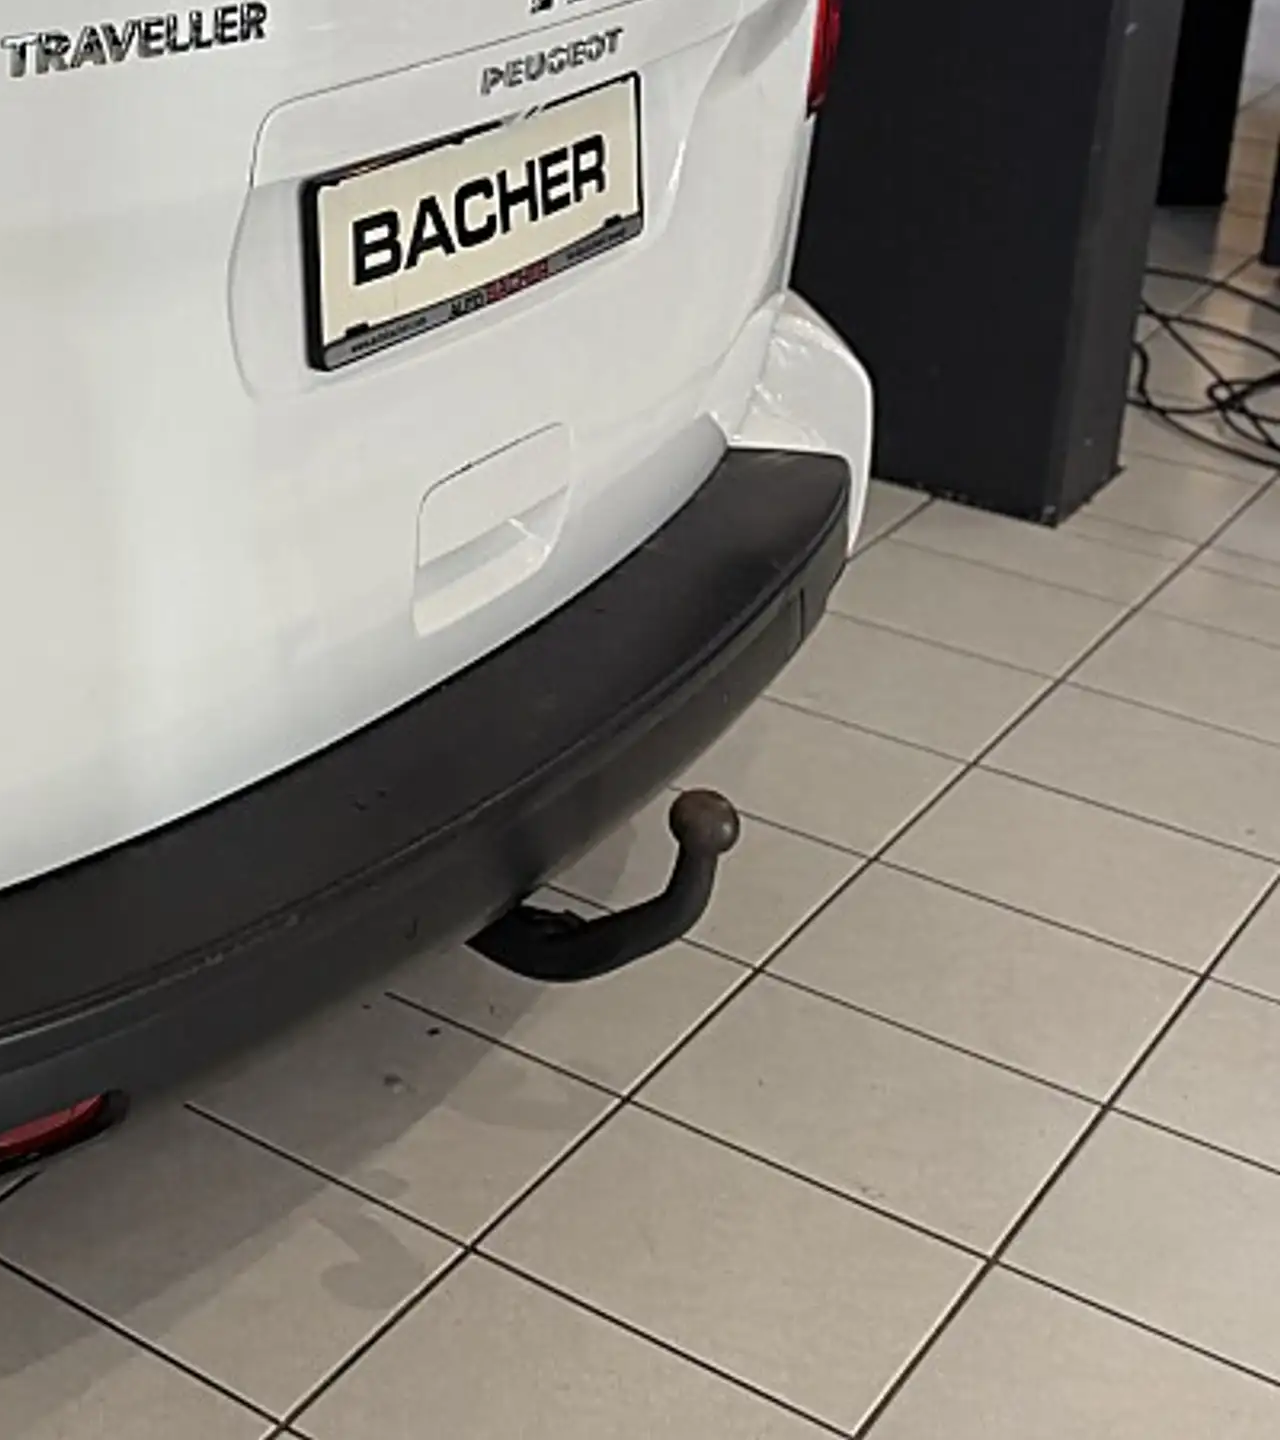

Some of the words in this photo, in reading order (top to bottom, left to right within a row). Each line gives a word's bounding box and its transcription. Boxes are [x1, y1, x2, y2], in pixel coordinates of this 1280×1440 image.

[0, 1, 268, 77] TRAVELLER
[480, 27, 624, 95] PEUGEOT
[353, 134, 606, 286] BACHER
